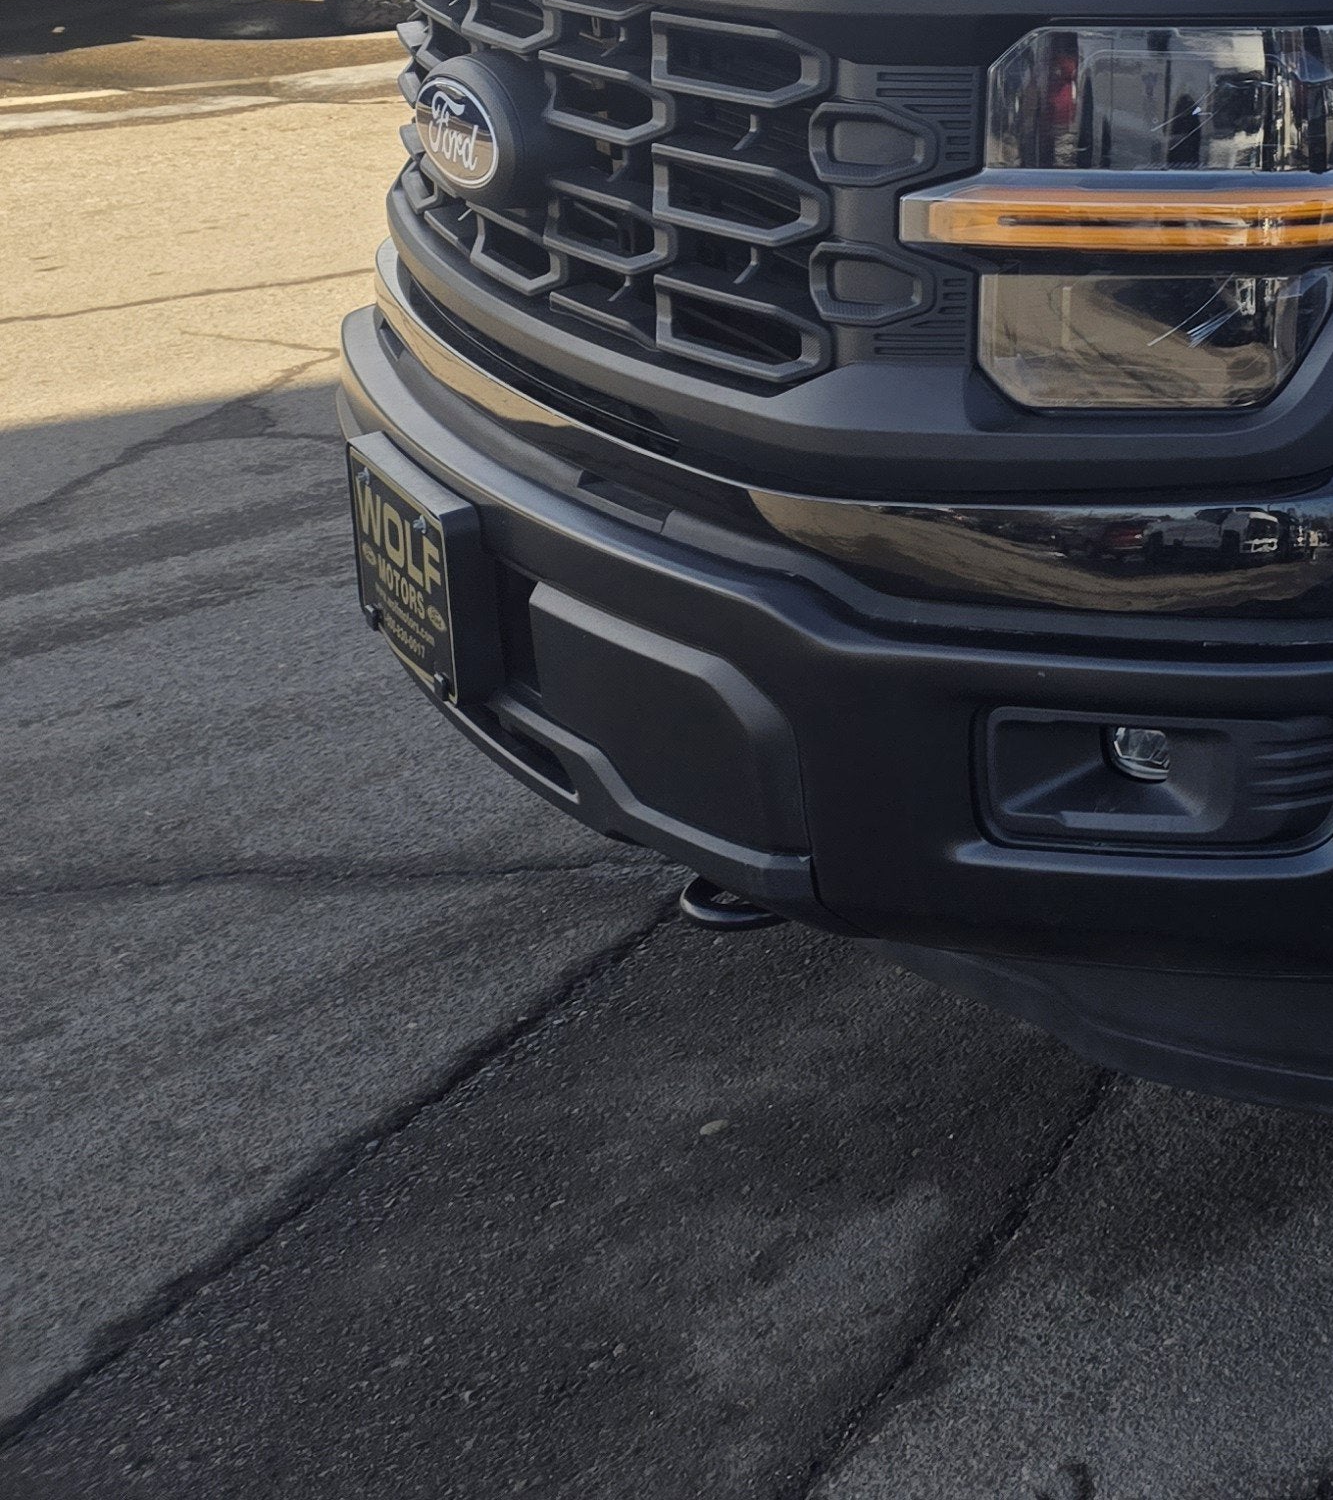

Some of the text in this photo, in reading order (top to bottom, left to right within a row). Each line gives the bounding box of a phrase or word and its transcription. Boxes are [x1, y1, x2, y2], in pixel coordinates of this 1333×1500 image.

[428, 90, 479, 172] Ford
[356, 475, 442, 595] WOLF
[378, 553, 426, 620] MOTORS
